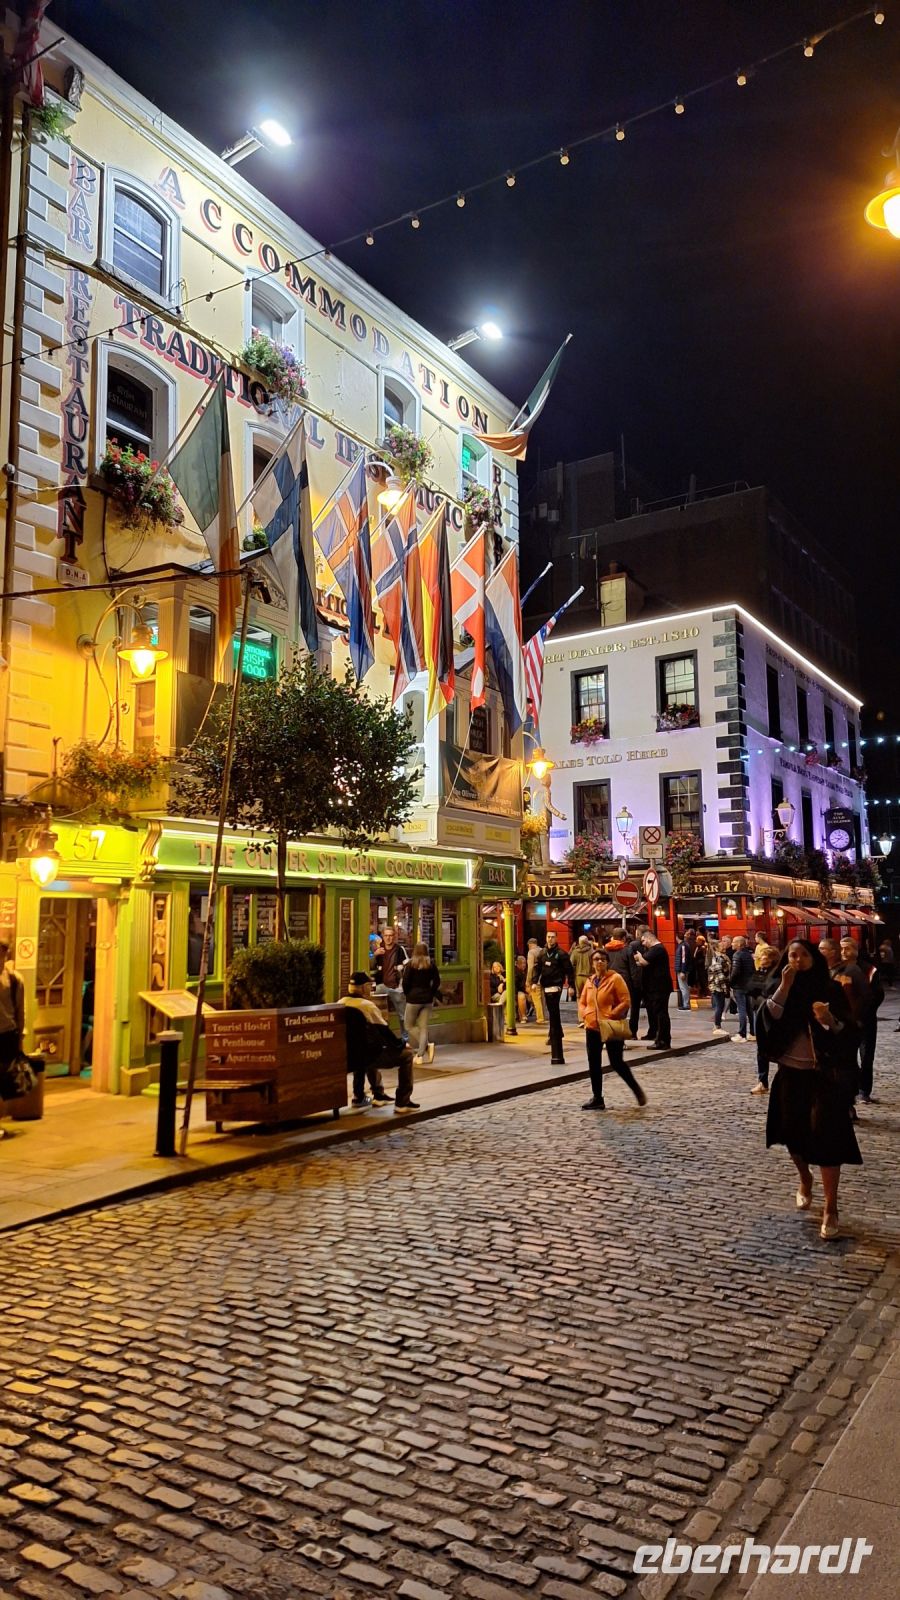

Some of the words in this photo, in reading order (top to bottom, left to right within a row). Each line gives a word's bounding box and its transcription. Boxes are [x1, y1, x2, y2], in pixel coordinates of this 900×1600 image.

[66, 154, 97, 251] BAR
[155, 166, 489, 434] ACCOMMODATION
[113, 294, 327, 451] TRADITIONL
[58, 264, 92, 563] RESTAURANT
[568, 642, 627, 661] DEALER,
[586, 754, 623, 766] TOLD
[627, 748, 668, 761] HERE
[73, 829, 107, 861] 57
[194, 839, 236, 868] THE
[244, 846, 310, 872] OLIER
[344, 854, 378, 877] JOHN
[384, 857, 445, 881] GOGARTY
[487, 867, 508, 883] BAR
[527, 883, 620, 898] DUBLINE
[724, 880, 740, 893] 17
[212, 1023, 242, 1033] Tourist
[244, 1021, 271, 1031] Hostel
[284, 1015, 301, 1026] Trad
[213, 1038, 220, 1048] &
[222, 1037, 265, 1047] Penthouse
[288, 1033, 303, 1043] Late
[304, 1031, 322, 1042] Night
[322, 1029, 335, 1039] Bar
[226, 1053, 276, 1064] Apartments
[306, 1049, 322, 1060] Days
